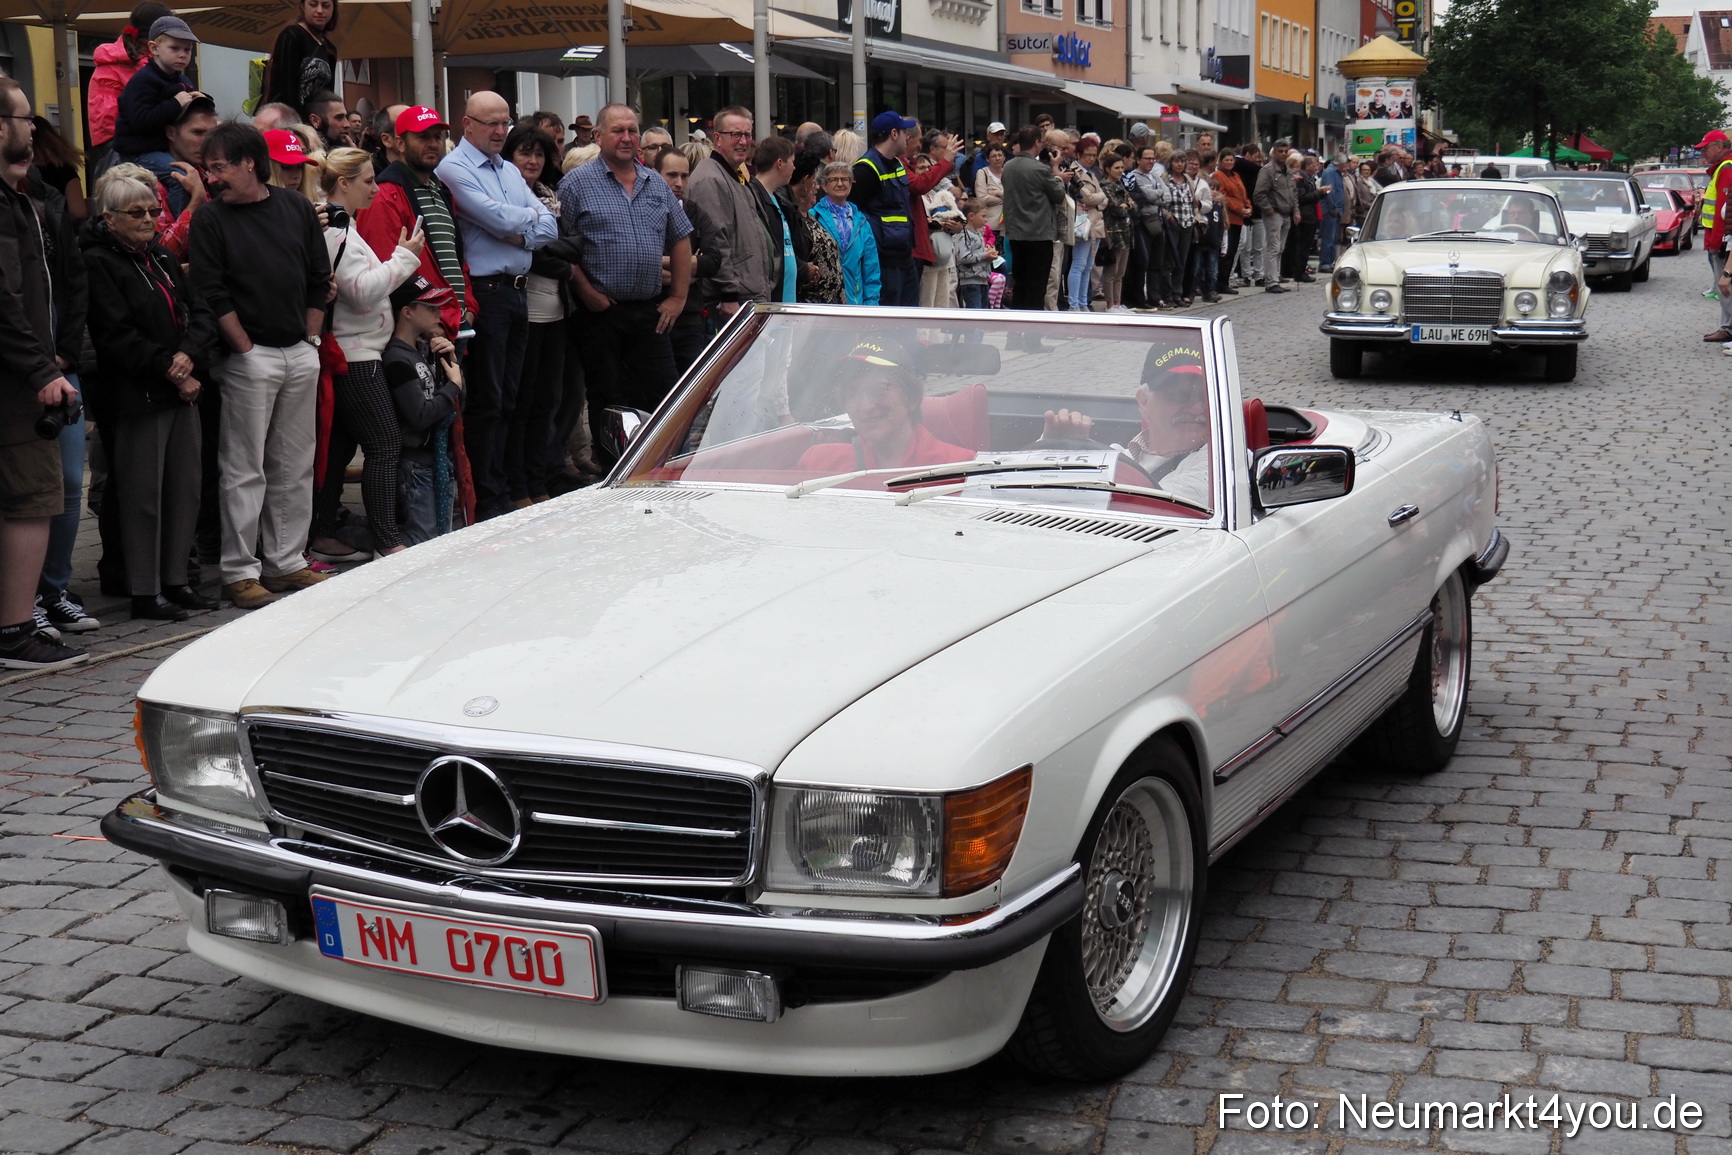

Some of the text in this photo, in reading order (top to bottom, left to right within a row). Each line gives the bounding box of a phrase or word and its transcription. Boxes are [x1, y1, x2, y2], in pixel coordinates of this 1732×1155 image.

[1420, 329, 1442, 340] LAU
[1451, 329, 1465, 341] WE
[1468, 329, 1489, 341] 69H
[356, 912, 565, 987] NM 0700
